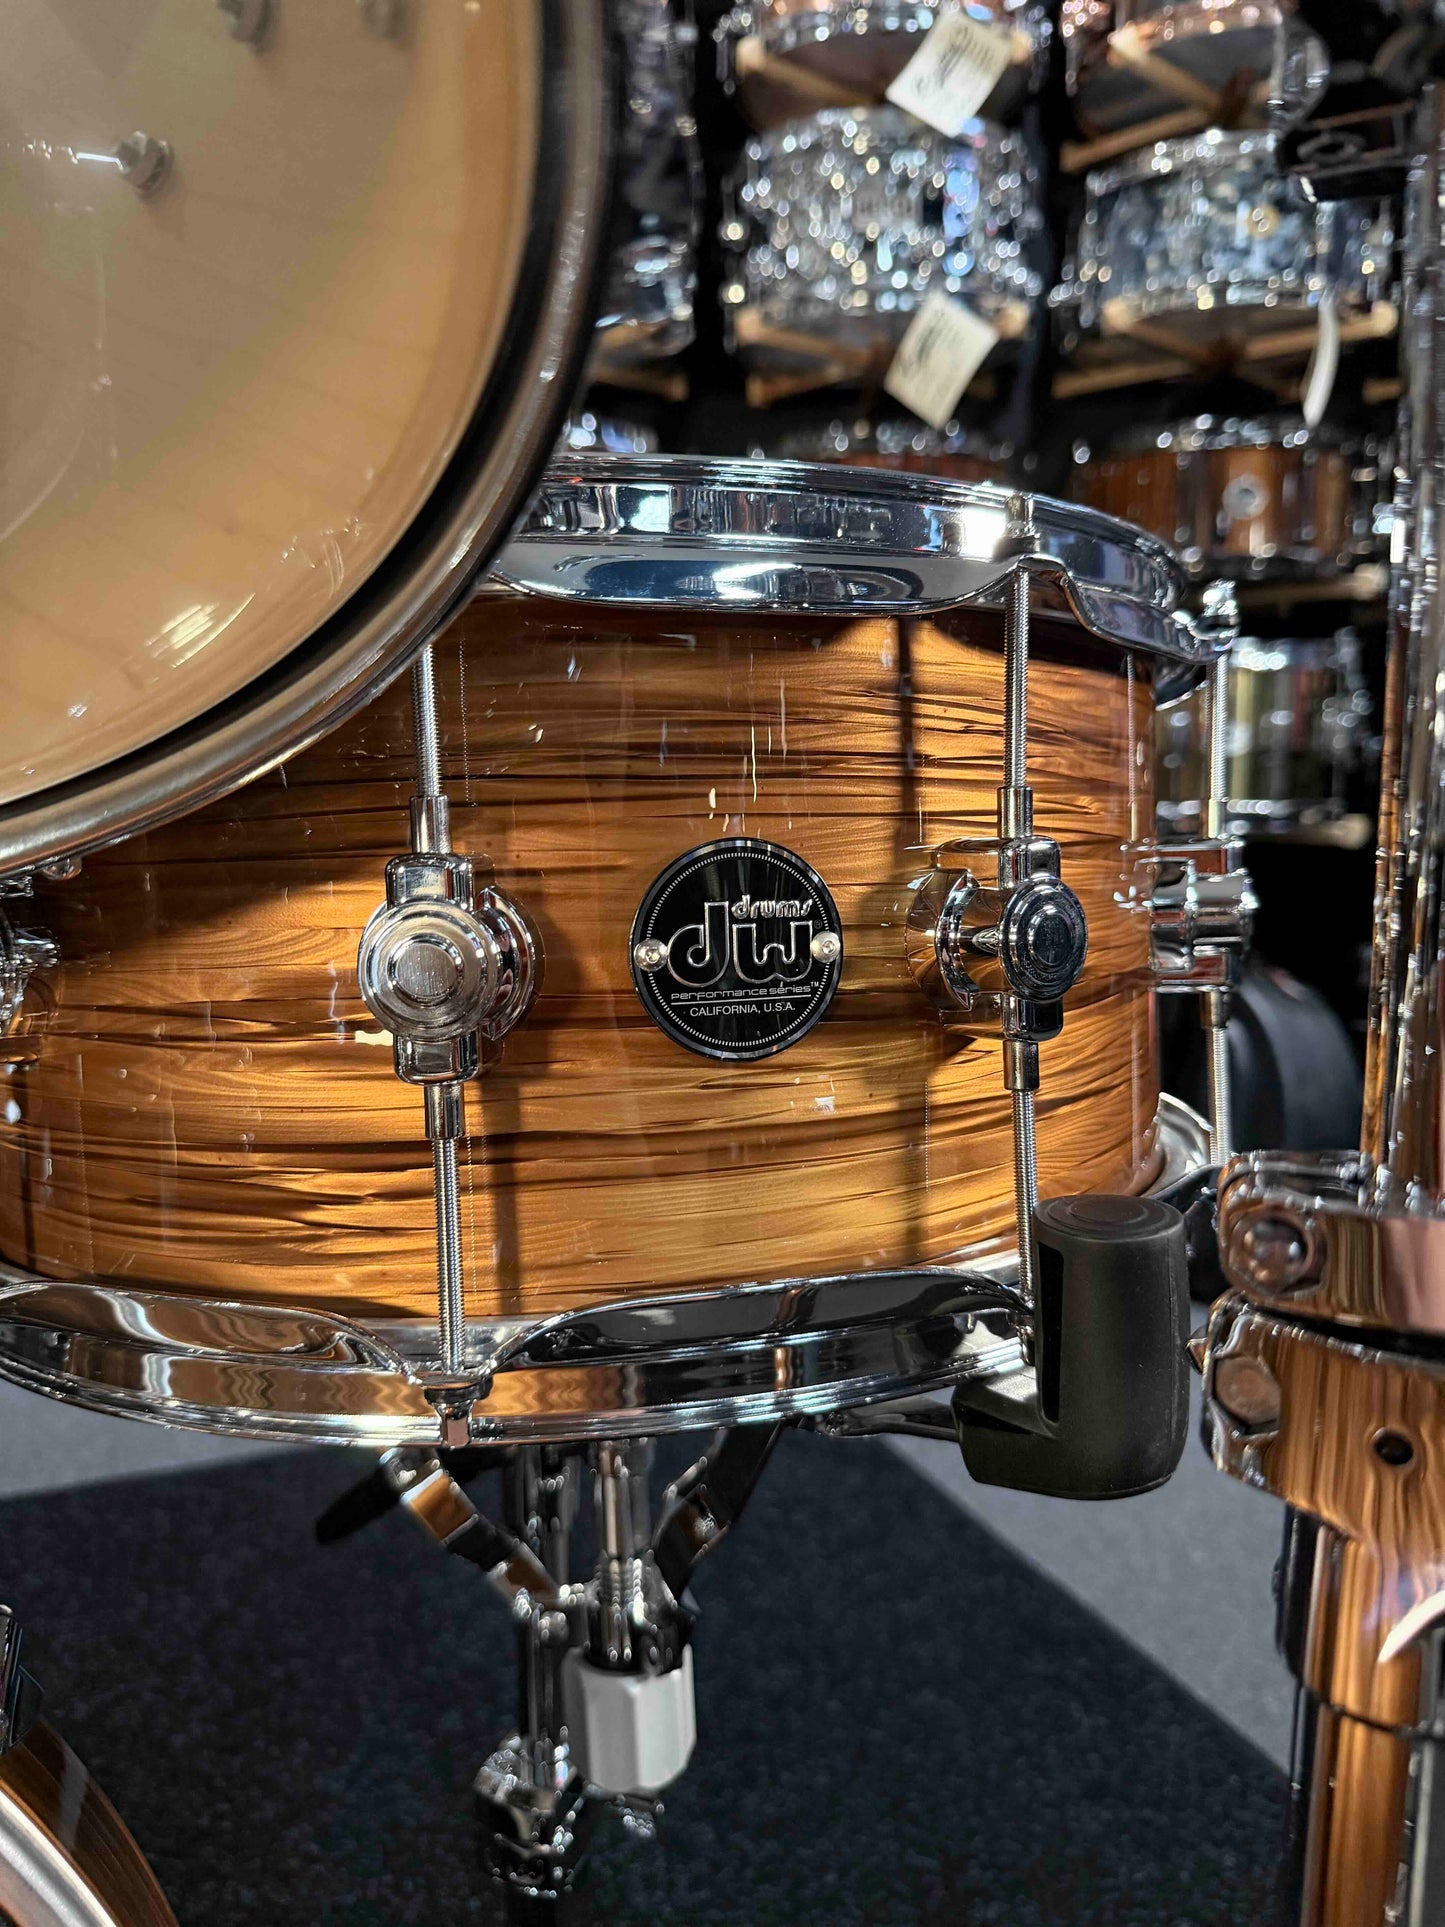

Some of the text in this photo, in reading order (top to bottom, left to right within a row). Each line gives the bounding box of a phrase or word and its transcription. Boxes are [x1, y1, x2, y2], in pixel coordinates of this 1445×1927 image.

[731, 894, 812, 919] drums
[690, 1001, 796, 1017] CALIFORNIA, U.S.A.
